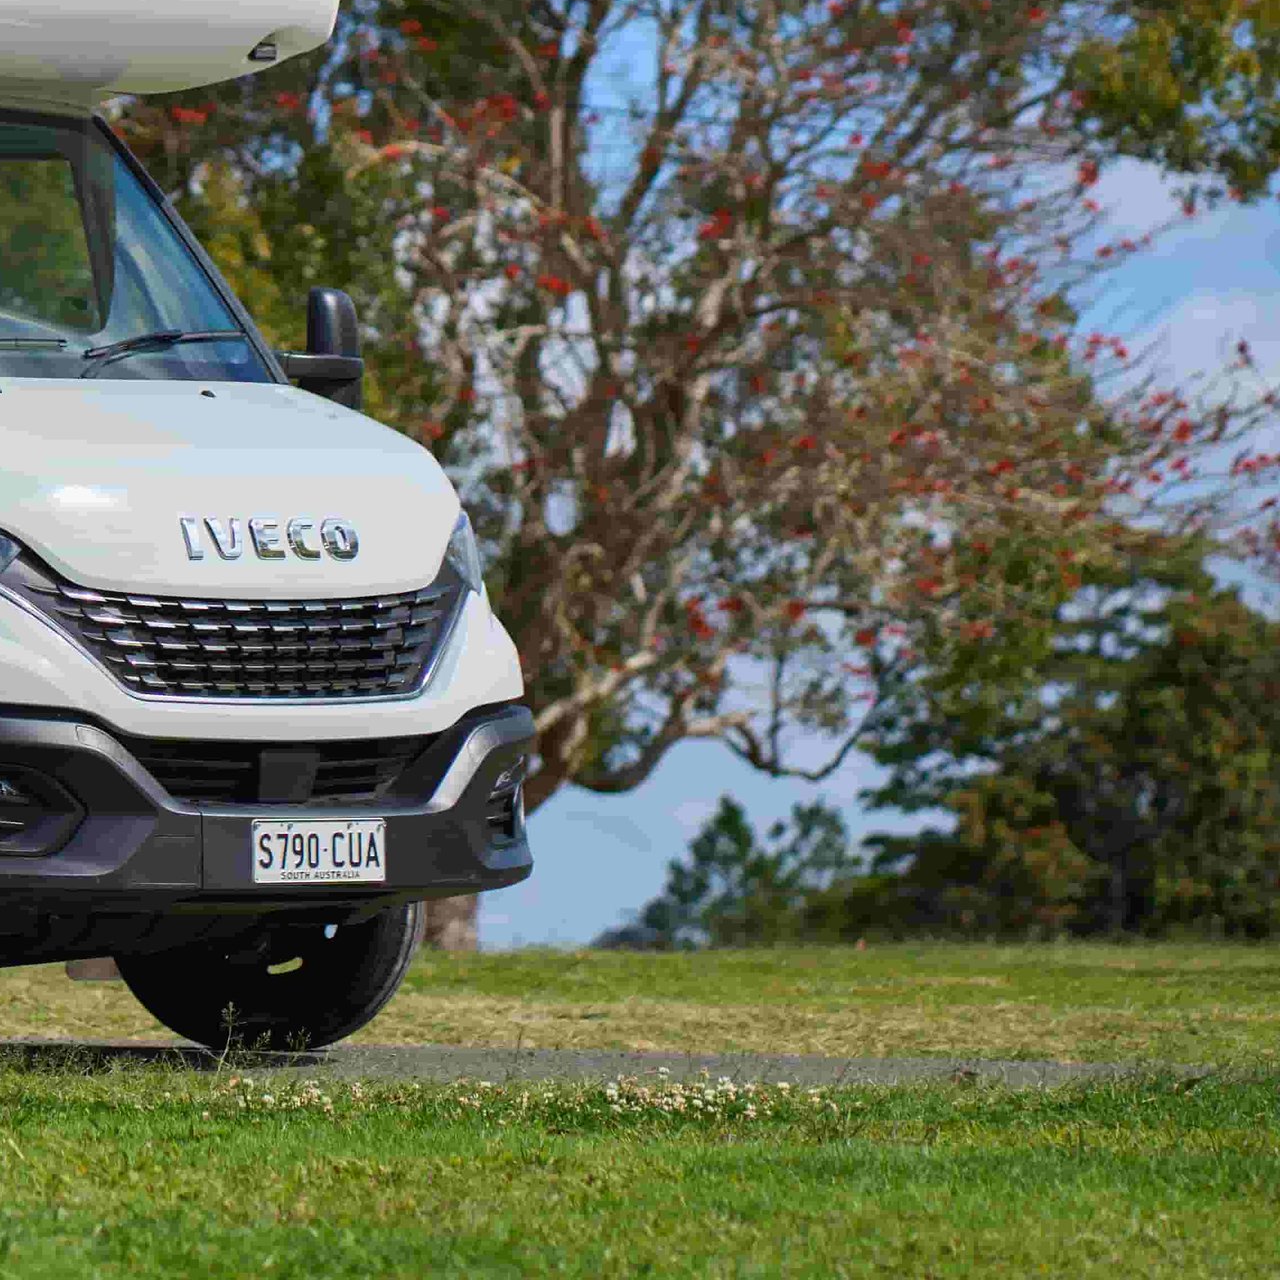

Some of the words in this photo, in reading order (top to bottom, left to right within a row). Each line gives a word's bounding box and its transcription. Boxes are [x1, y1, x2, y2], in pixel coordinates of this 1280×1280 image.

[179, 516, 360, 562] IVECO
[280, 871, 310, 880] SOUTH
[313, 870, 360, 880] AUSTRALIA
